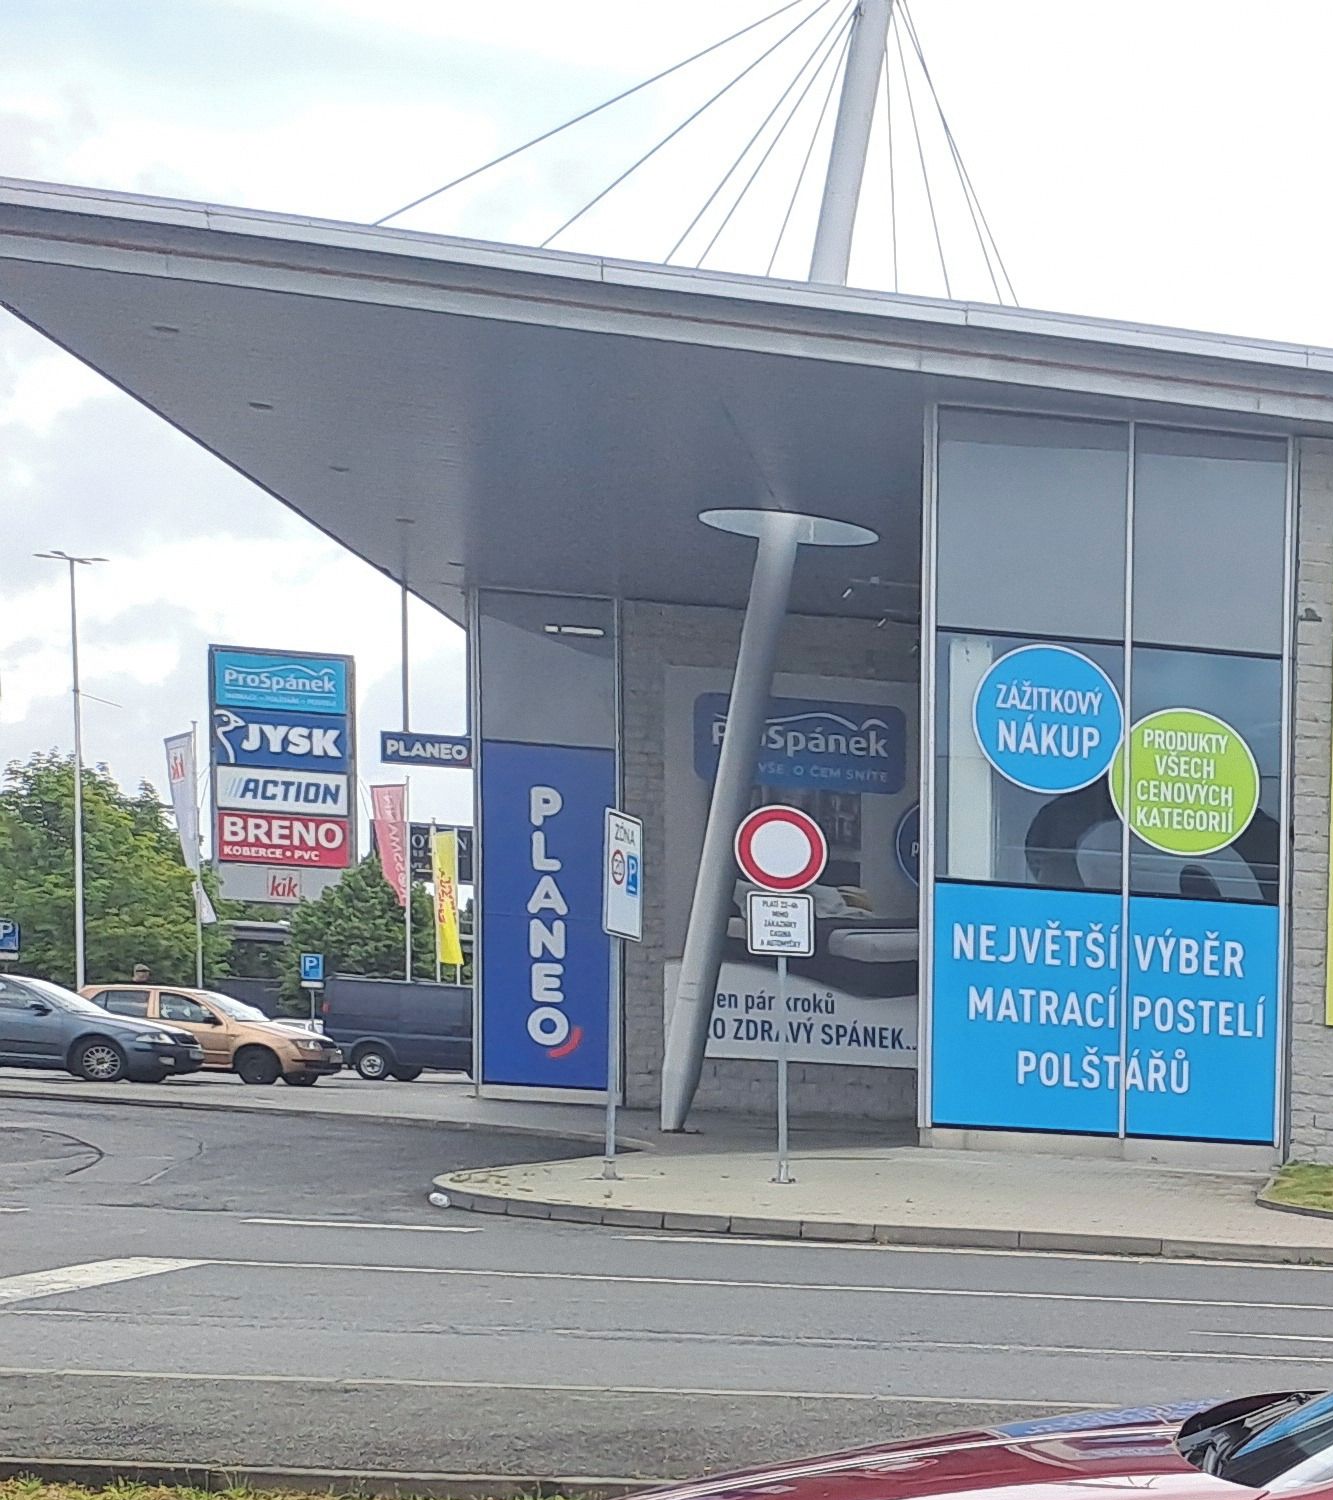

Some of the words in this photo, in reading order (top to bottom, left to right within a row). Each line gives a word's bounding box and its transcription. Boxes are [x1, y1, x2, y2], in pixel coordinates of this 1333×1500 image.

[224, 669, 337, 693] ProSpánek
[995, 679, 1102, 716] ZÁŽITKOVÝ
[240, 723, 343, 758] JYSK
[386, 739, 468, 761] PLANEO
[997, 714, 1101, 760] NÁKUP
[1143, 728, 1229, 754] PRODUKTY
[793, 764, 804, 776] O
[809, 763, 841, 778] ČEM
[846, 768, 889, 784] SNÍTE
[1154, 751, 1215, 780] VŠECH
[239, 777, 341, 805] ACTION
[1136, 775, 1233, 808] CENOVÝCH
[223, 816, 344, 849] BRENO
[1136, 807, 1234, 834] KATEGORIÍ
[223, 845, 283, 859] KOBERCE
[294, 850, 320, 861] PVC
[270, 875, 298, 897] kik
[526, 785, 571, 1047] PLANEO
[952, 920, 1121, 970] NEJVĚTŠÍ
[1133, 927, 1245, 978] VÝBĚR
[745, 989, 776, 1014] pár
[967, 985, 1119, 1030] MATRACÍ
[1132, 995, 1266, 1038] POSTELÍ
[1016, 1045, 1190, 1095] POLŠTÁŘŮ
